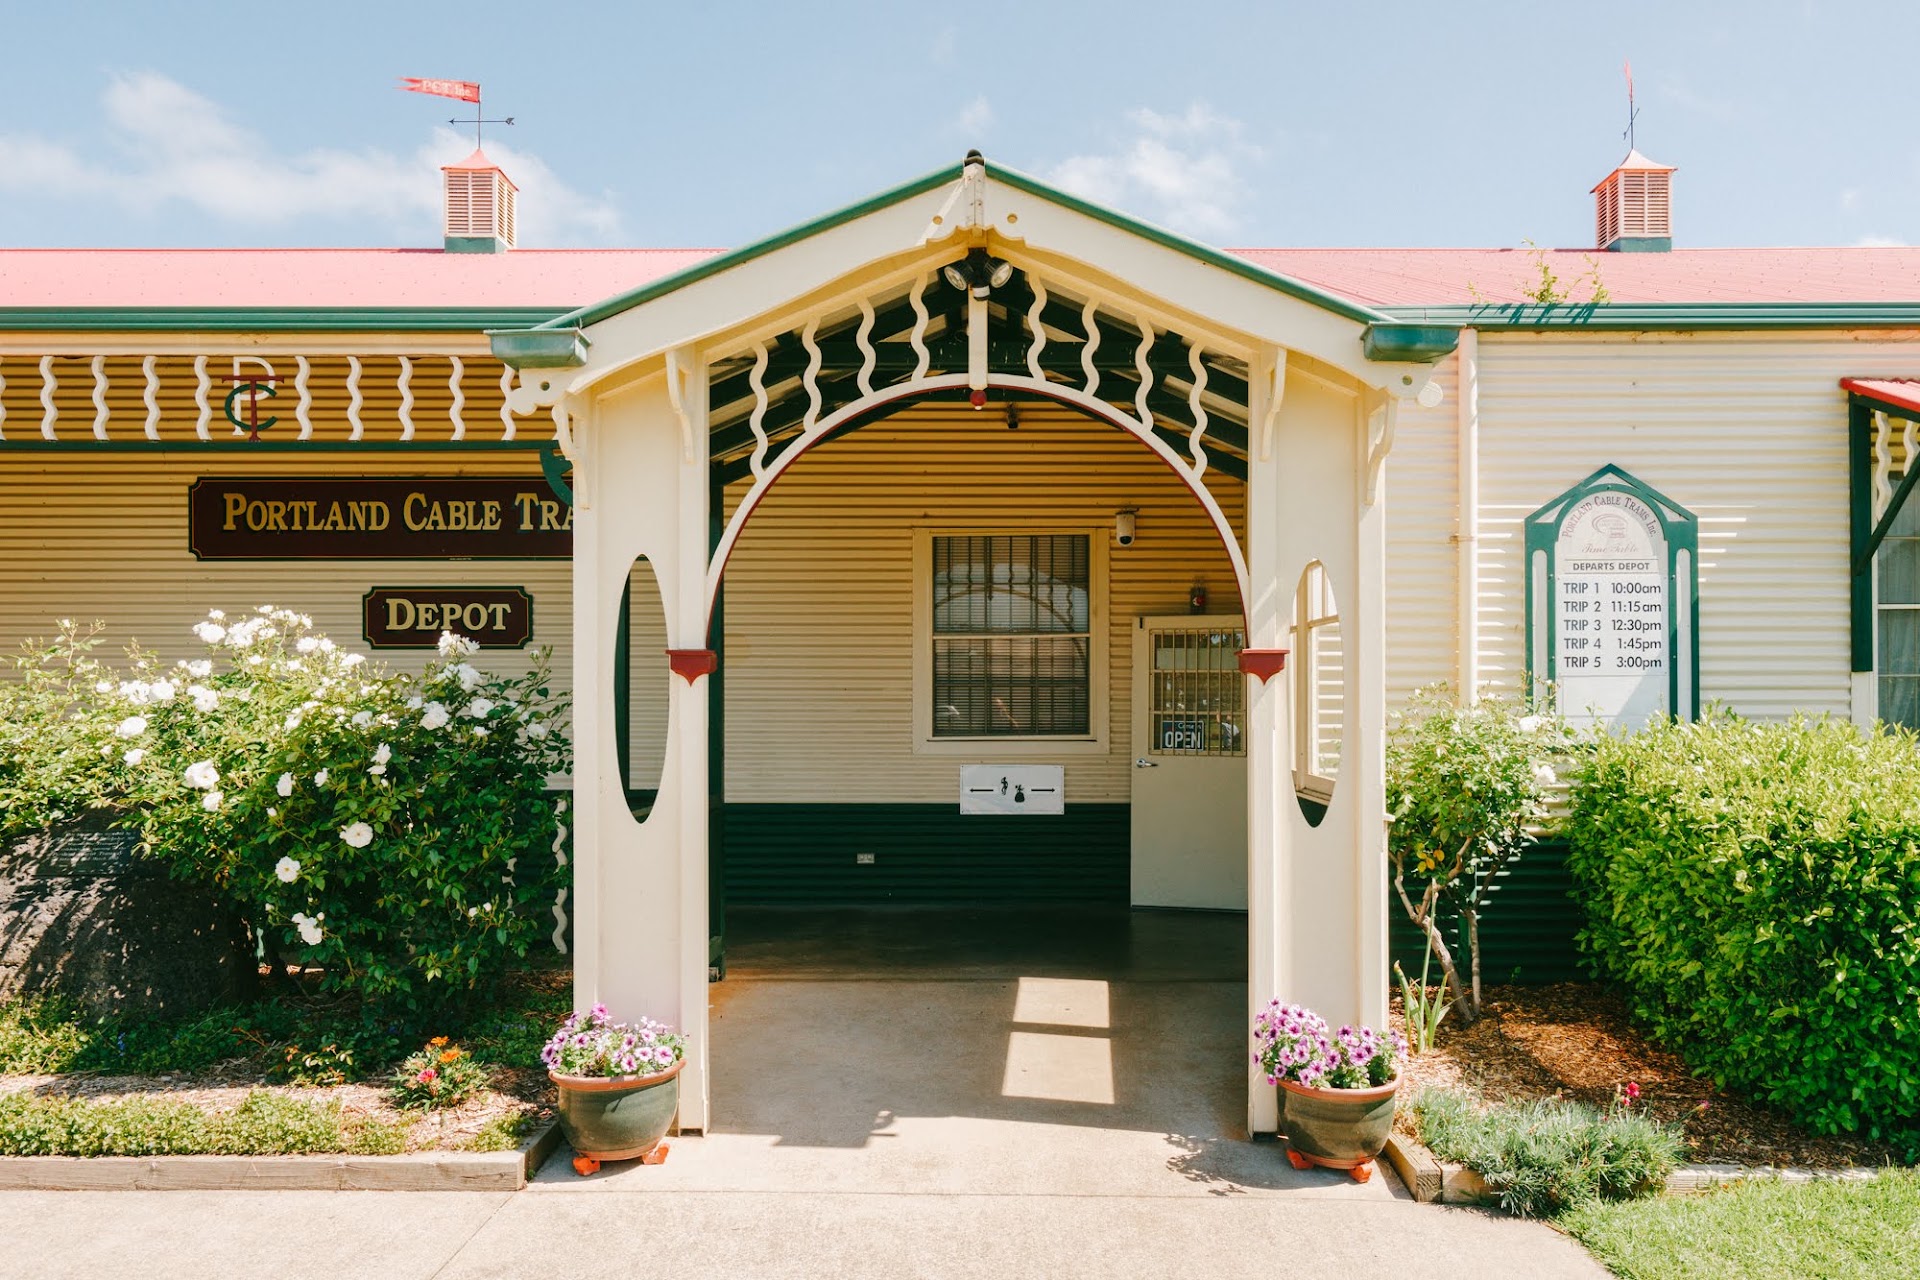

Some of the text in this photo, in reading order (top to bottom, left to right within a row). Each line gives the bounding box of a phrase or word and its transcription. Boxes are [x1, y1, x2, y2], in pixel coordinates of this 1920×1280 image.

[223, 493, 390, 531] PORTLAND
[404, 492, 501, 531] CABLE
[1562, 502, 1592, 538] PORTLAND
[1594, 495, 1620, 506] CABLE
[1624, 497, 1650, 521] TRAMS
[1573, 562, 1650, 571] DEPARTS DEPOT
[1564, 583, 1662, 594] TRIP 1 10:00am
[1564, 600, 1662, 612] TRIP 2 11:15am
[384, 598, 512, 631] DEPOT
[1564, 619, 1662, 633] TRIP 3 12:30pm
[1564, 637, 1662, 652] TRIP 4 1:45pm
[1564, 656, 1662, 670] TRIP 5 3:00pm
[1165, 731, 1201, 748] OPEN
